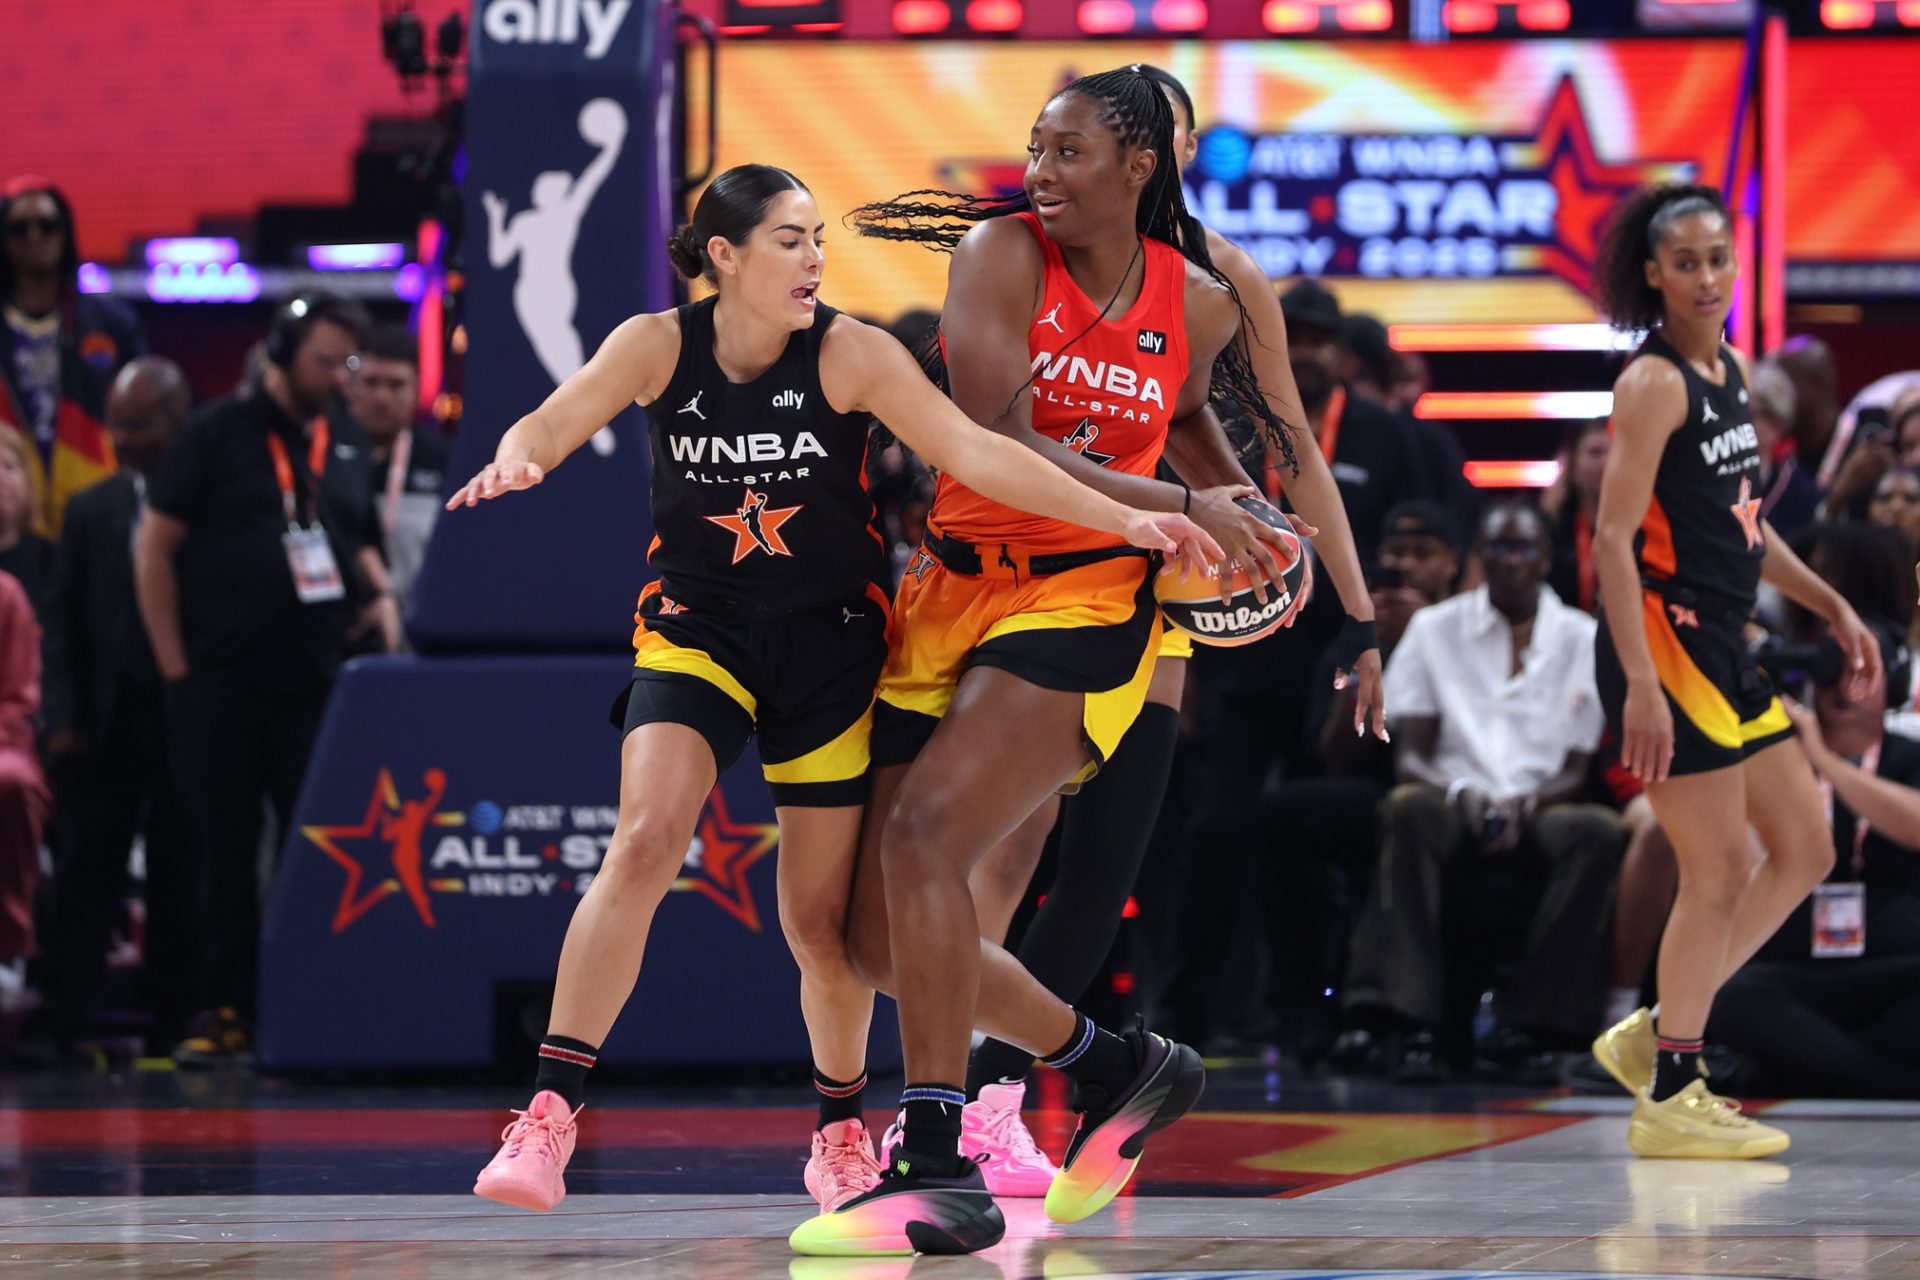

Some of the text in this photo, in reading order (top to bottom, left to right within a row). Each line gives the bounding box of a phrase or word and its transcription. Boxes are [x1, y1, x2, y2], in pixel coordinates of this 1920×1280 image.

[483, 0, 631, 59] ally
[1352, 134, 1498, 178] WNBA
[1336, 178, 1558, 238] STAR
[1138, 331, 1163, 353] ally
[772, 389, 805, 410] ally
[1032, 385, 1150, 425] ALL-STAR
[669, 431, 829, 464] WNBA
[1700, 423, 1758, 466] WNB
[685, 467, 810, 484] ALL-STAR
[1190, 591, 1292, 633] Wilson
[503, 805, 565, 831] AT&T
[430, 835, 542, 870] ALL
[468, 872, 557, 897] INDY
